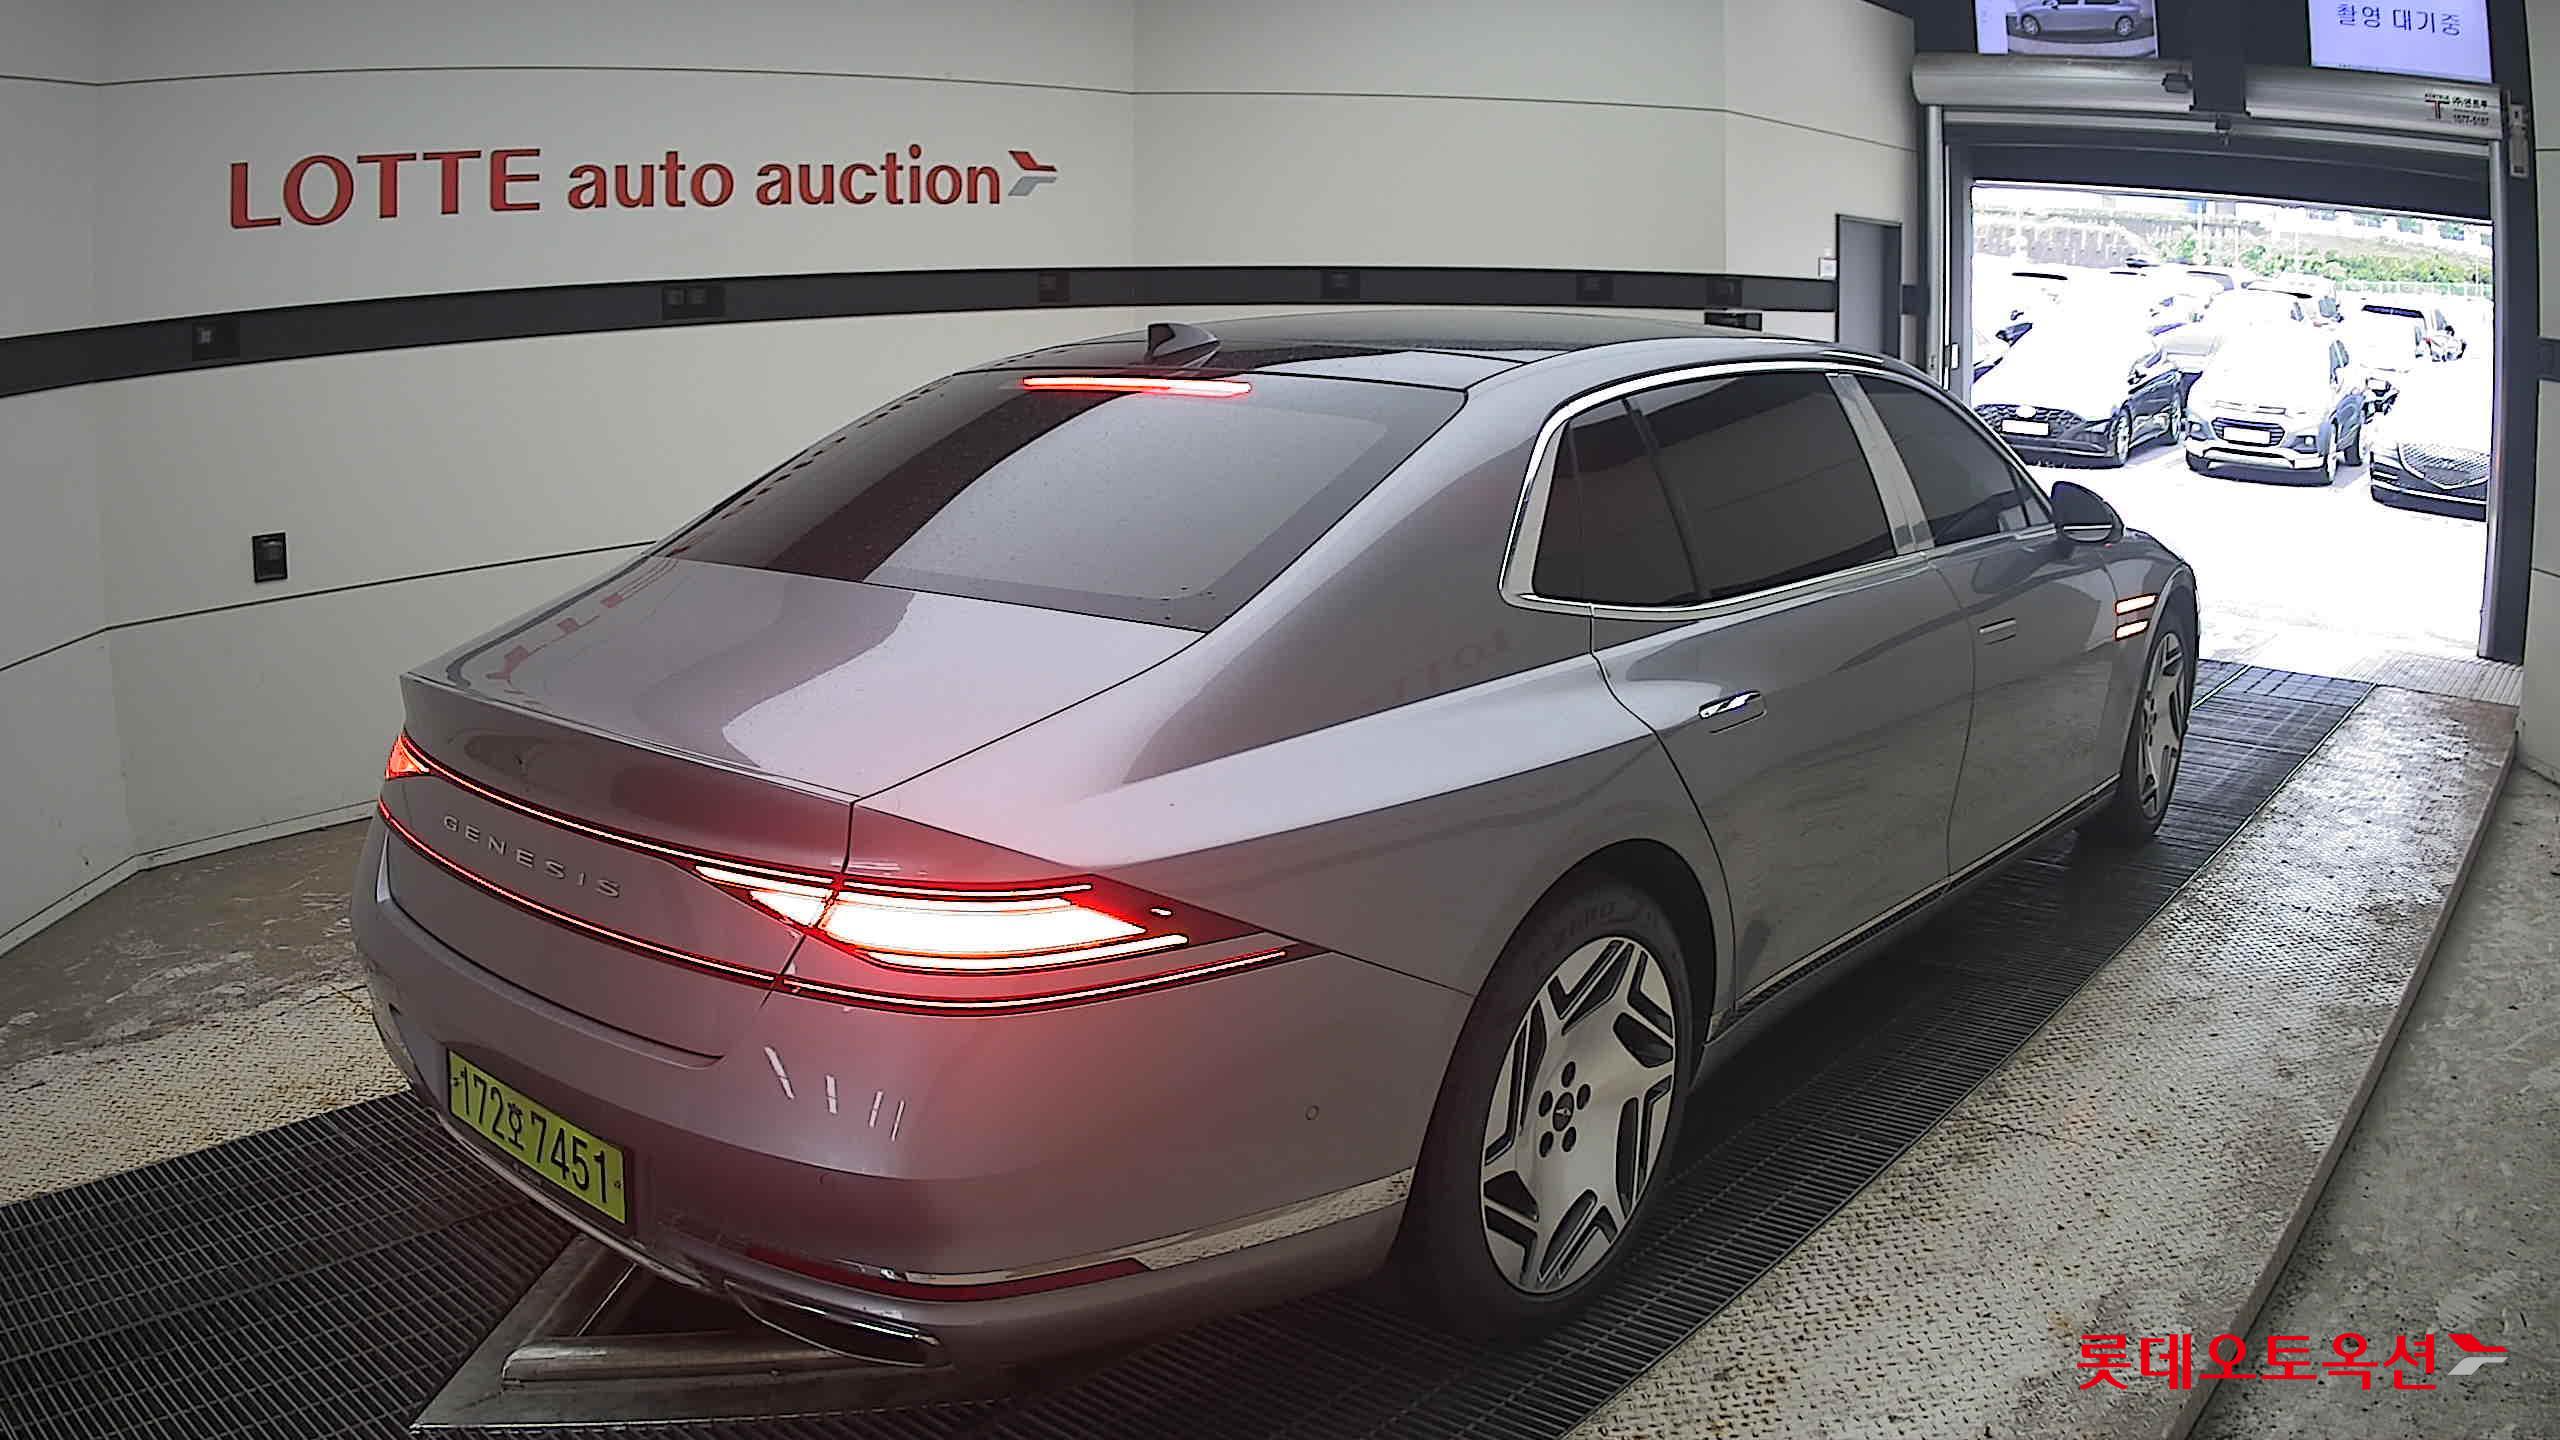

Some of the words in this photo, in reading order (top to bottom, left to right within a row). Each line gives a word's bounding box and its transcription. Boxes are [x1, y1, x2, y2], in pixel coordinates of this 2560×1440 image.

[2337, 3, 2381, 29] 촬영
[2392, 9, 2461, 37] 대기중
[230, 148, 541, 230] LOTTE
[568, 150, 734, 209] auto
[757, 144, 1001, 207] auction
[442, 815, 621, 898] GENESIS
